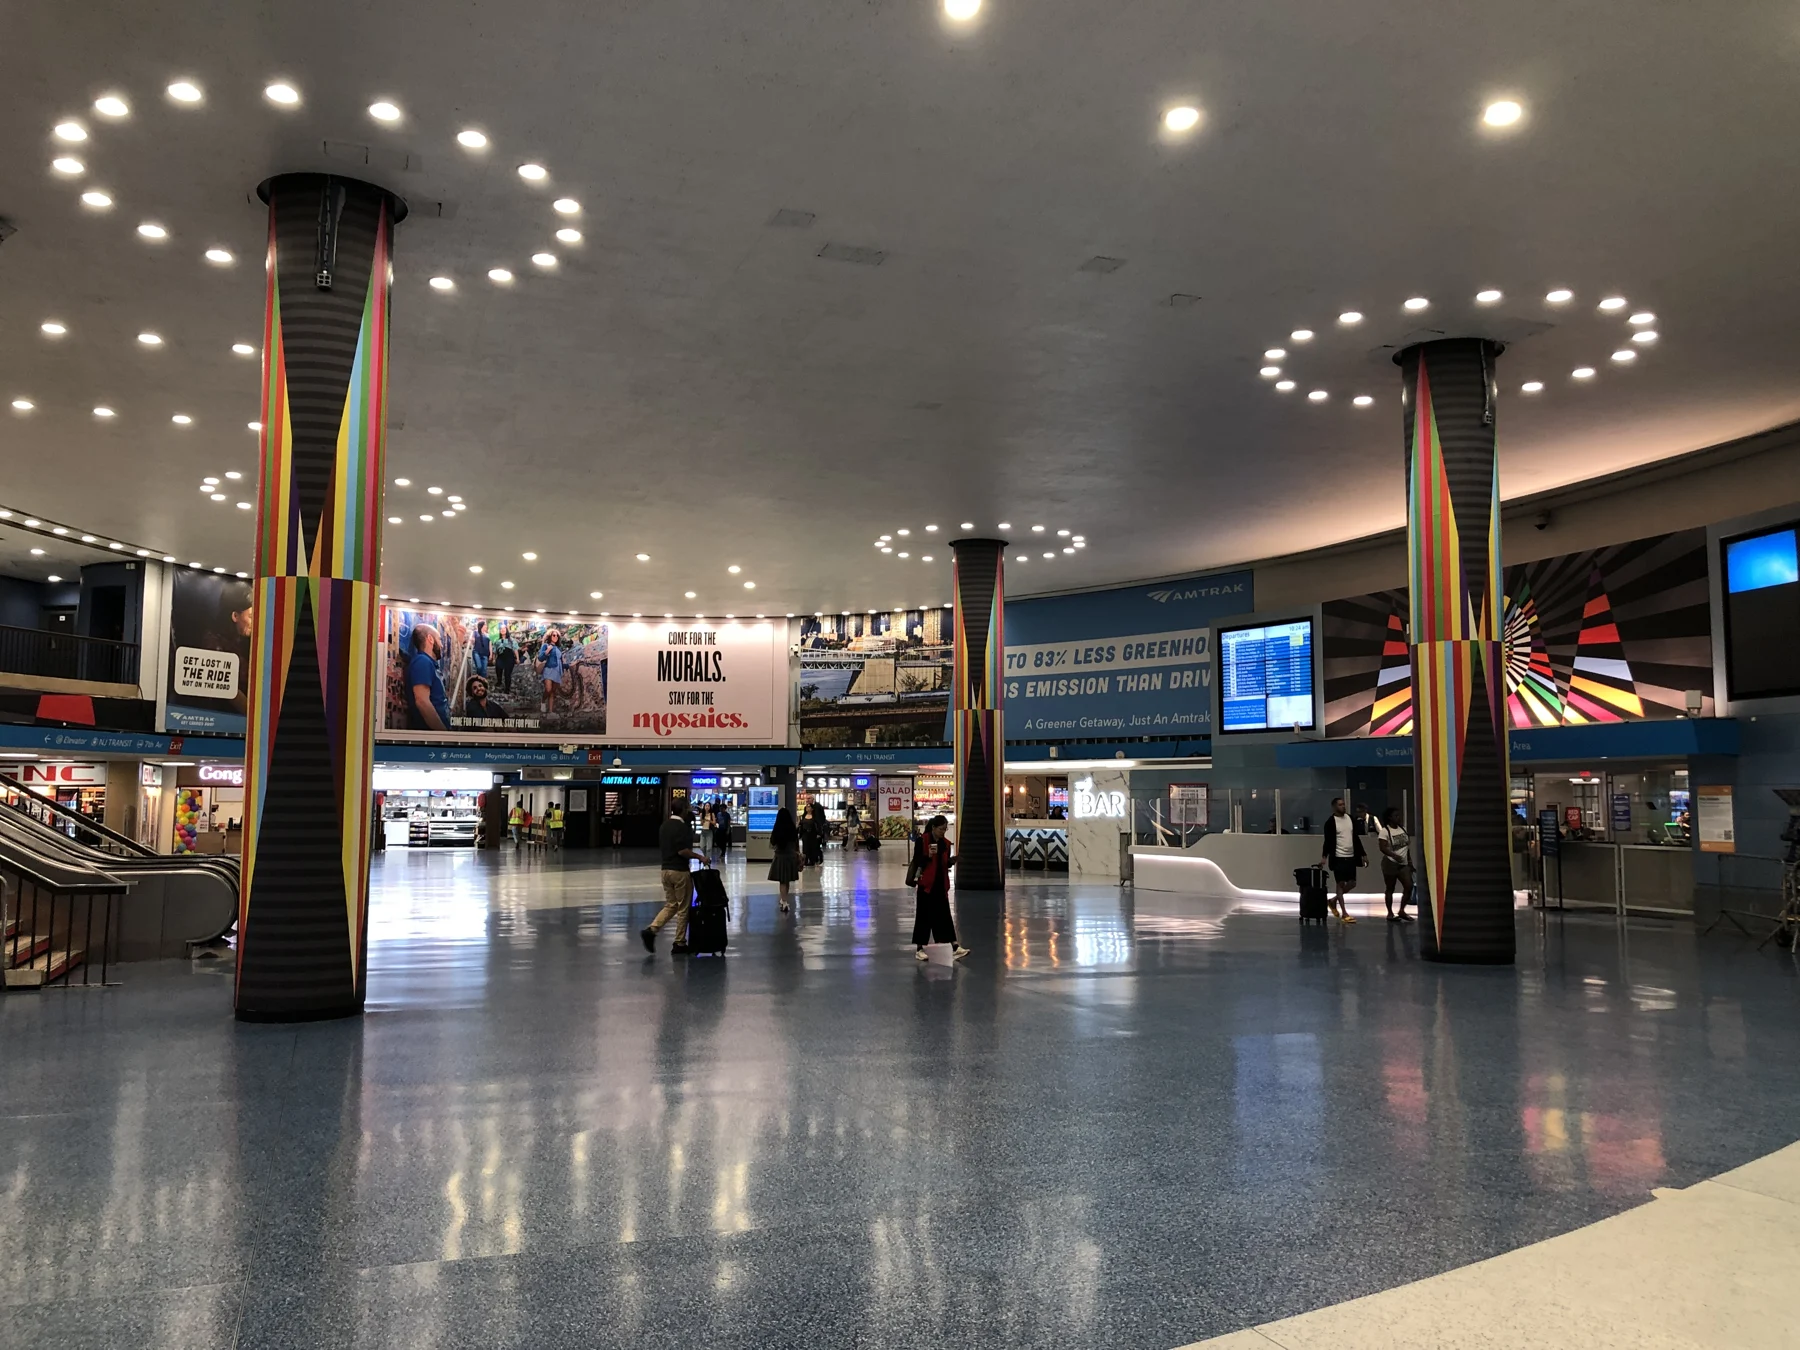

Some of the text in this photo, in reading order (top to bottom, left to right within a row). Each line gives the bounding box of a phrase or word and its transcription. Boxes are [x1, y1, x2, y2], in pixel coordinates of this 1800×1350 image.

[1173, 583, 1244, 601] AMTRAK
[668, 631, 716, 645] COME FOR THE
[1222, 632, 1250, 640] Departures
[1006, 636, 1210, 669] TO 83% LESS GREENHO
[183, 656, 232, 669] GET LOST IN
[657, 650, 726, 682] MURALS.
[183, 666, 231, 682] THE RIDE
[1025, 676, 1109, 699] EMISSION
[1116, 672, 1162, 693] THAN
[668, 691, 714, 705] STAY FOR THE
[450, 716, 463, 726] COME
[463, 717, 472, 726] FOR
[504, 718, 515, 728] STAY
[515, 718, 524, 728] FOR
[632, 707, 749, 736] mosaics.
[1024, 719, 1033, 730] A
[1035, 718, 1076, 729] Greener
[1079, 717, 1125, 730] Getaway,
[1129, 715, 1150, 726] Just
[1152, 713, 1168, 725] An
[1170, 710, 1211, 724] Amtrak
[63, 736, 87, 745] Elevator
[99, 739, 133, 747] NJ TRANSIT
[169, 741, 182, 750] Exit
[1513, 741, 1531, 750] Area
[485, 752, 514, 760] Moynihan
[199, 766, 243, 784] Gong
[601, 776, 633, 785] AMTRAK
[879, 786, 911, 795] SALAD
[1076, 791, 1125, 817] BAR
